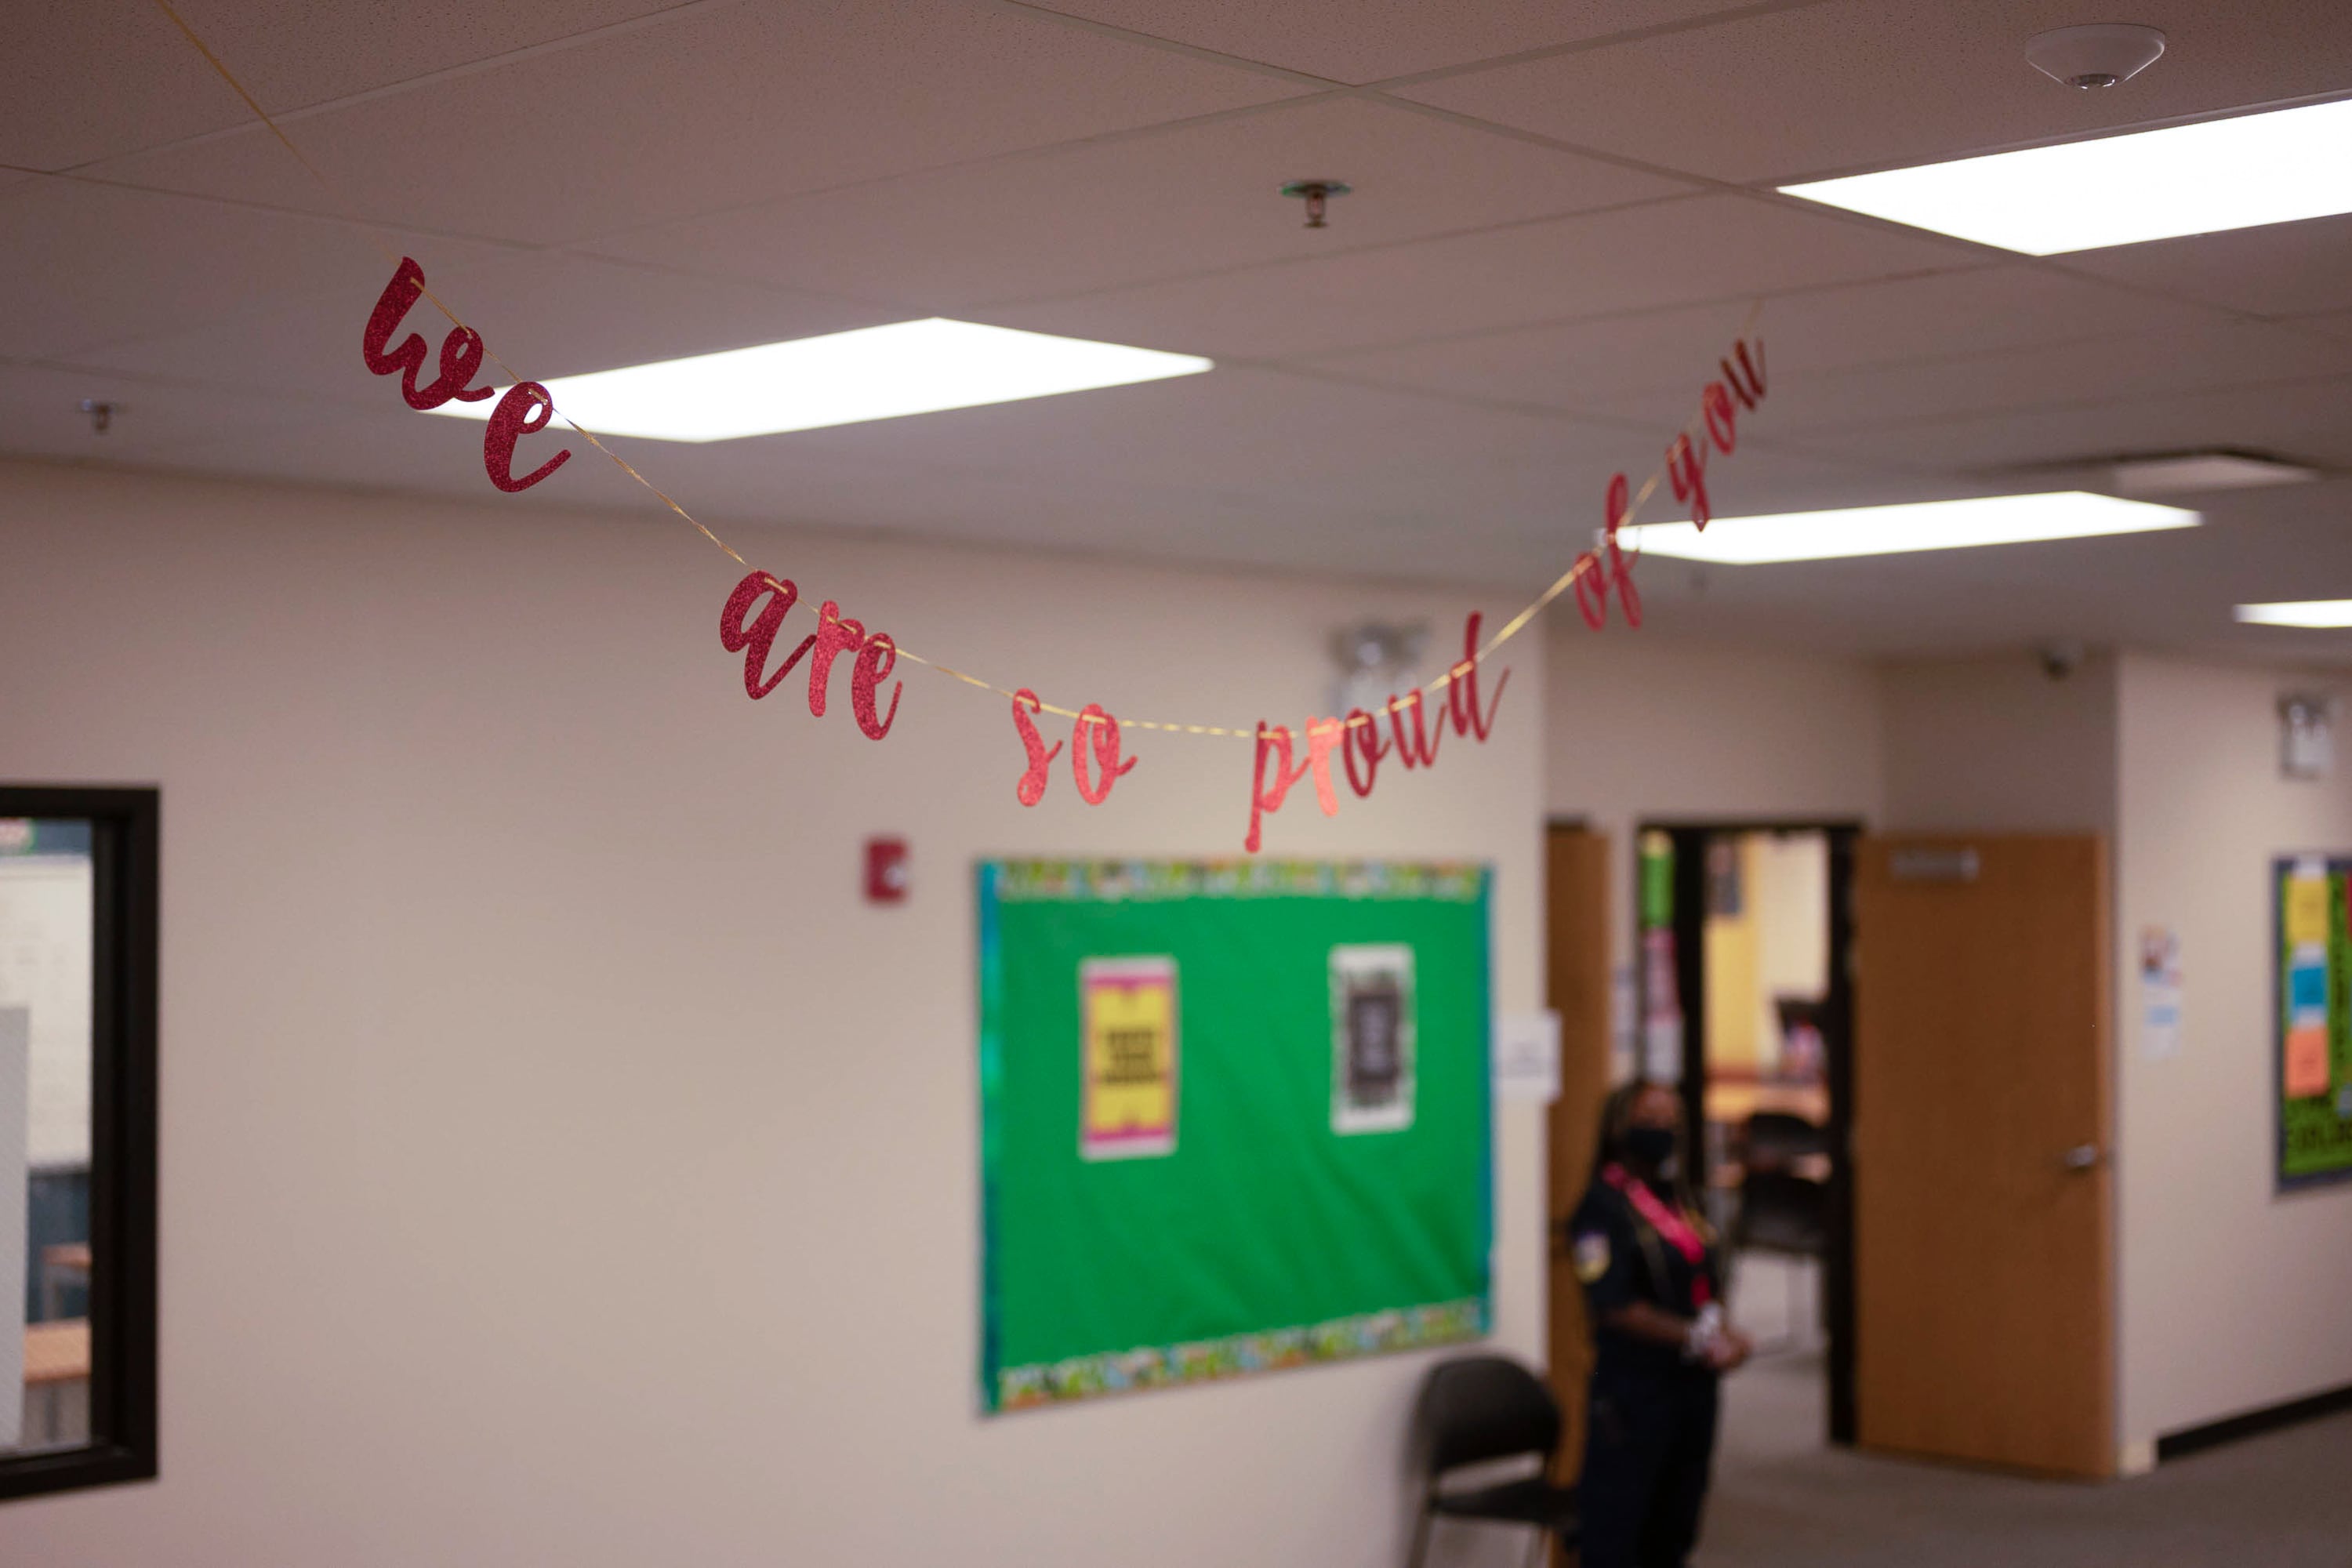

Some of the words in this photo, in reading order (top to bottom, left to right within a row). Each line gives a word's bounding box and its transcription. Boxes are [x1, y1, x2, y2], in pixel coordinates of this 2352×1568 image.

[363, 256, 571, 492] we
[720, 570, 902, 740] are
[1012, 688, 1138, 807] so
[1245, 612, 1511, 853] proud
[1572, 472, 1642, 630] of
[1665, 338, 1767, 532] you
